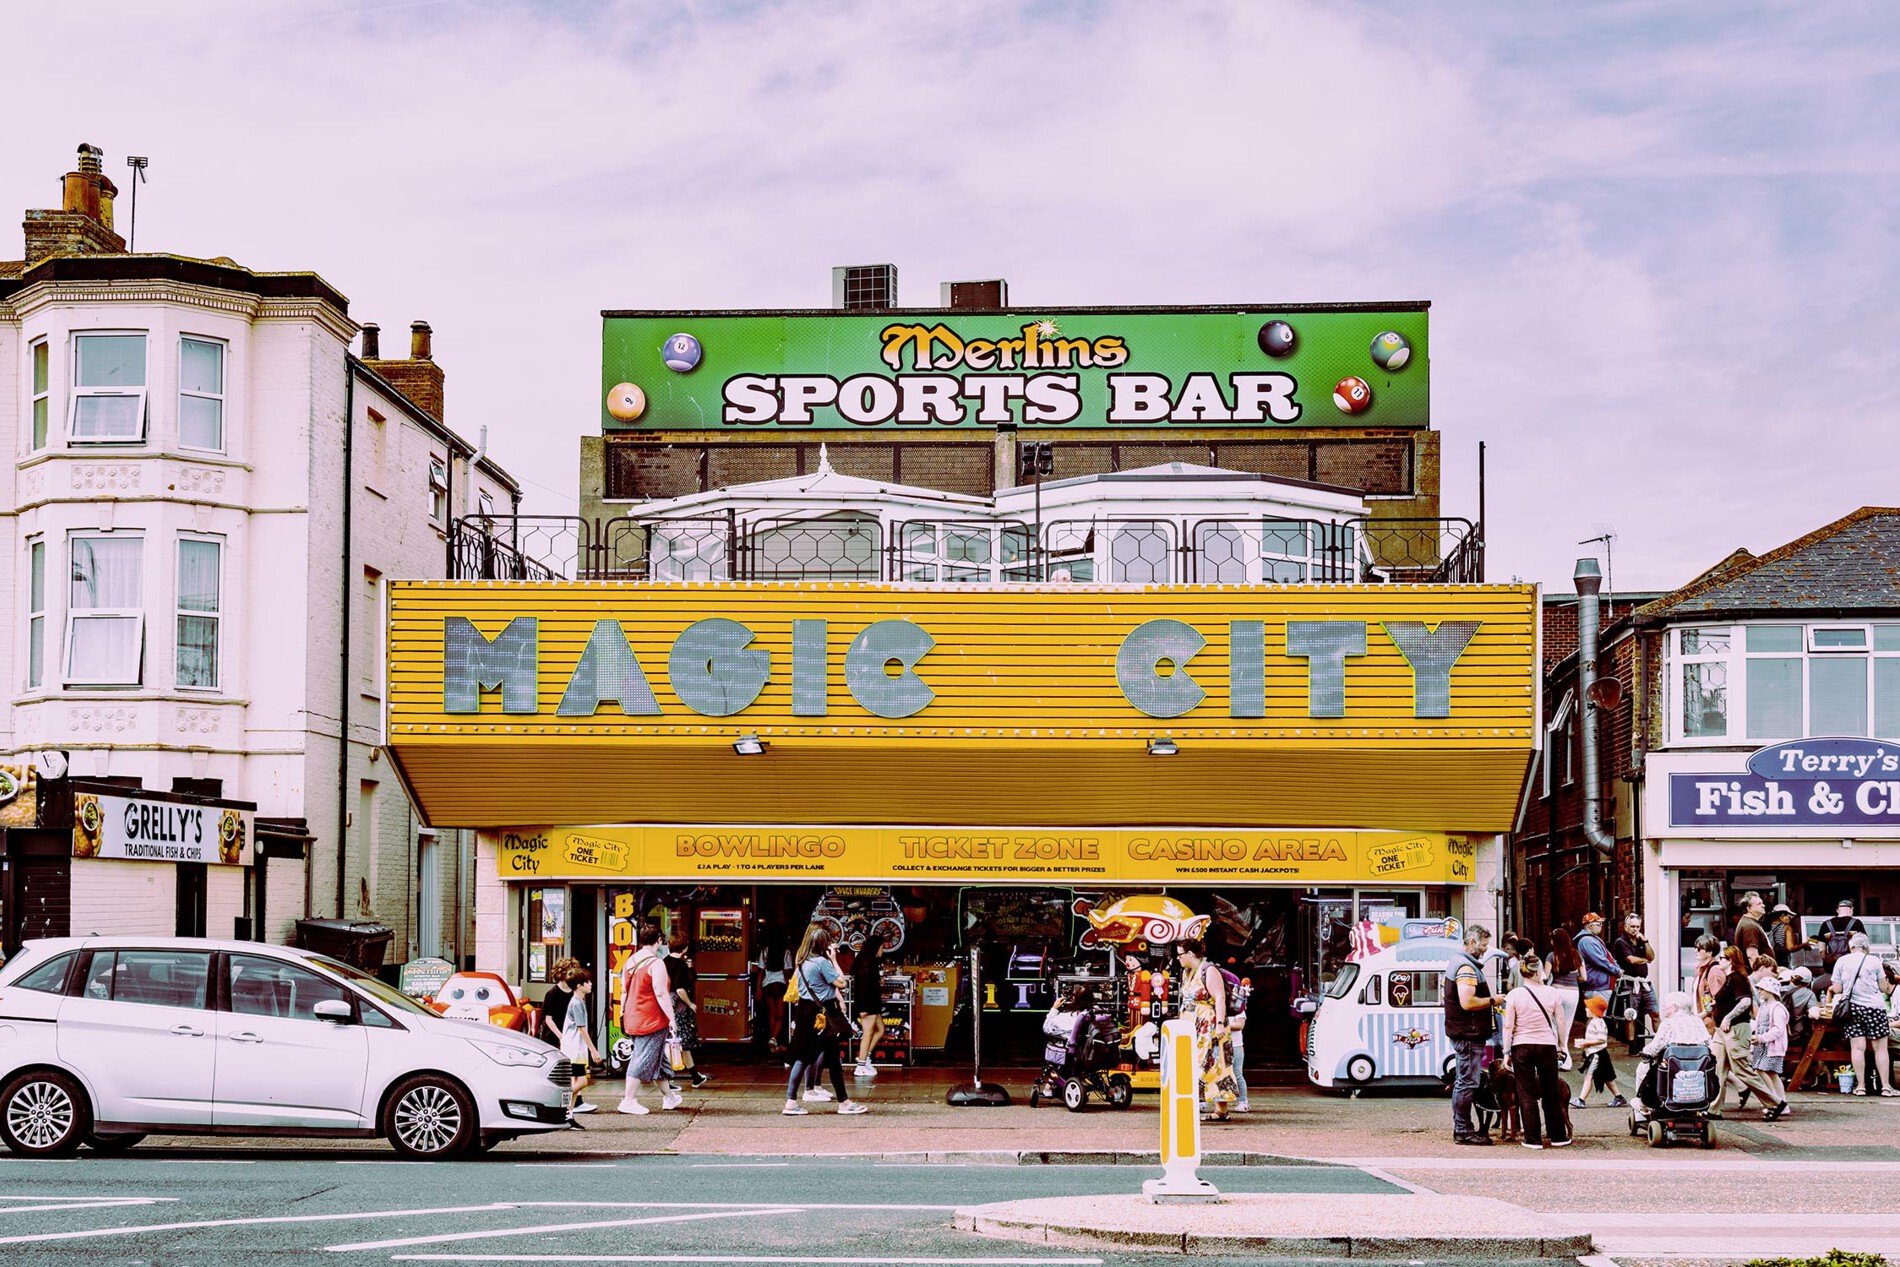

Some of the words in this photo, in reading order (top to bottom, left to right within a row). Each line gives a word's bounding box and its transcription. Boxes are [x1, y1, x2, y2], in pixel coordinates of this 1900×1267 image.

[677, 342, 686, 351] 12
[880, 322, 1130, 370] Merlins
[722, 373, 1082, 424] SPORTS
[1107, 372, 1301, 424] BAR
[1353, 388, 1363, 398] 11
[443, 616, 937, 719] MAGIC
[1115, 618, 1484, 718] CITY
[1779, 748, 1899, 777] Terry's
[1695, 781, 1796, 816] Fish
[1808, 781, 1845, 815] &
[124, 802, 203, 844] GRELLY'S
[124, 843, 164, 858] TRADITIONAL
[165, 846, 179, 859] FISH
[179, 847, 185, 859] &
[186, 847, 202, 860] CHIPS
[504, 833, 548, 852] Magic
[572, 837, 601, 849] Magic
[603, 842, 622, 853] City
[576, 846, 594, 856] ONE
[676, 835, 846, 858] BOWLINGO
[898, 836, 1009, 859] TICKET
[1014, 837, 1099, 860] ZONE
[1128, 838, 1247, 861] CASINO
[1252, 838, 1347, 861] AREA
[1374, 846, 1404, 856] Magic
[1405, 842, 1425, 850] City
[1447, 837, 1473, 858] Magic
[511, 855, 540, 874] City
[570, 853, 599, 865] TICKET
[1376, 860, 1406, 873] TICKET
[1381, 854, 1399, 864] ONE
[1452, 860, 1469, 880] City
[854, 887, 882, 895] INVADERS
